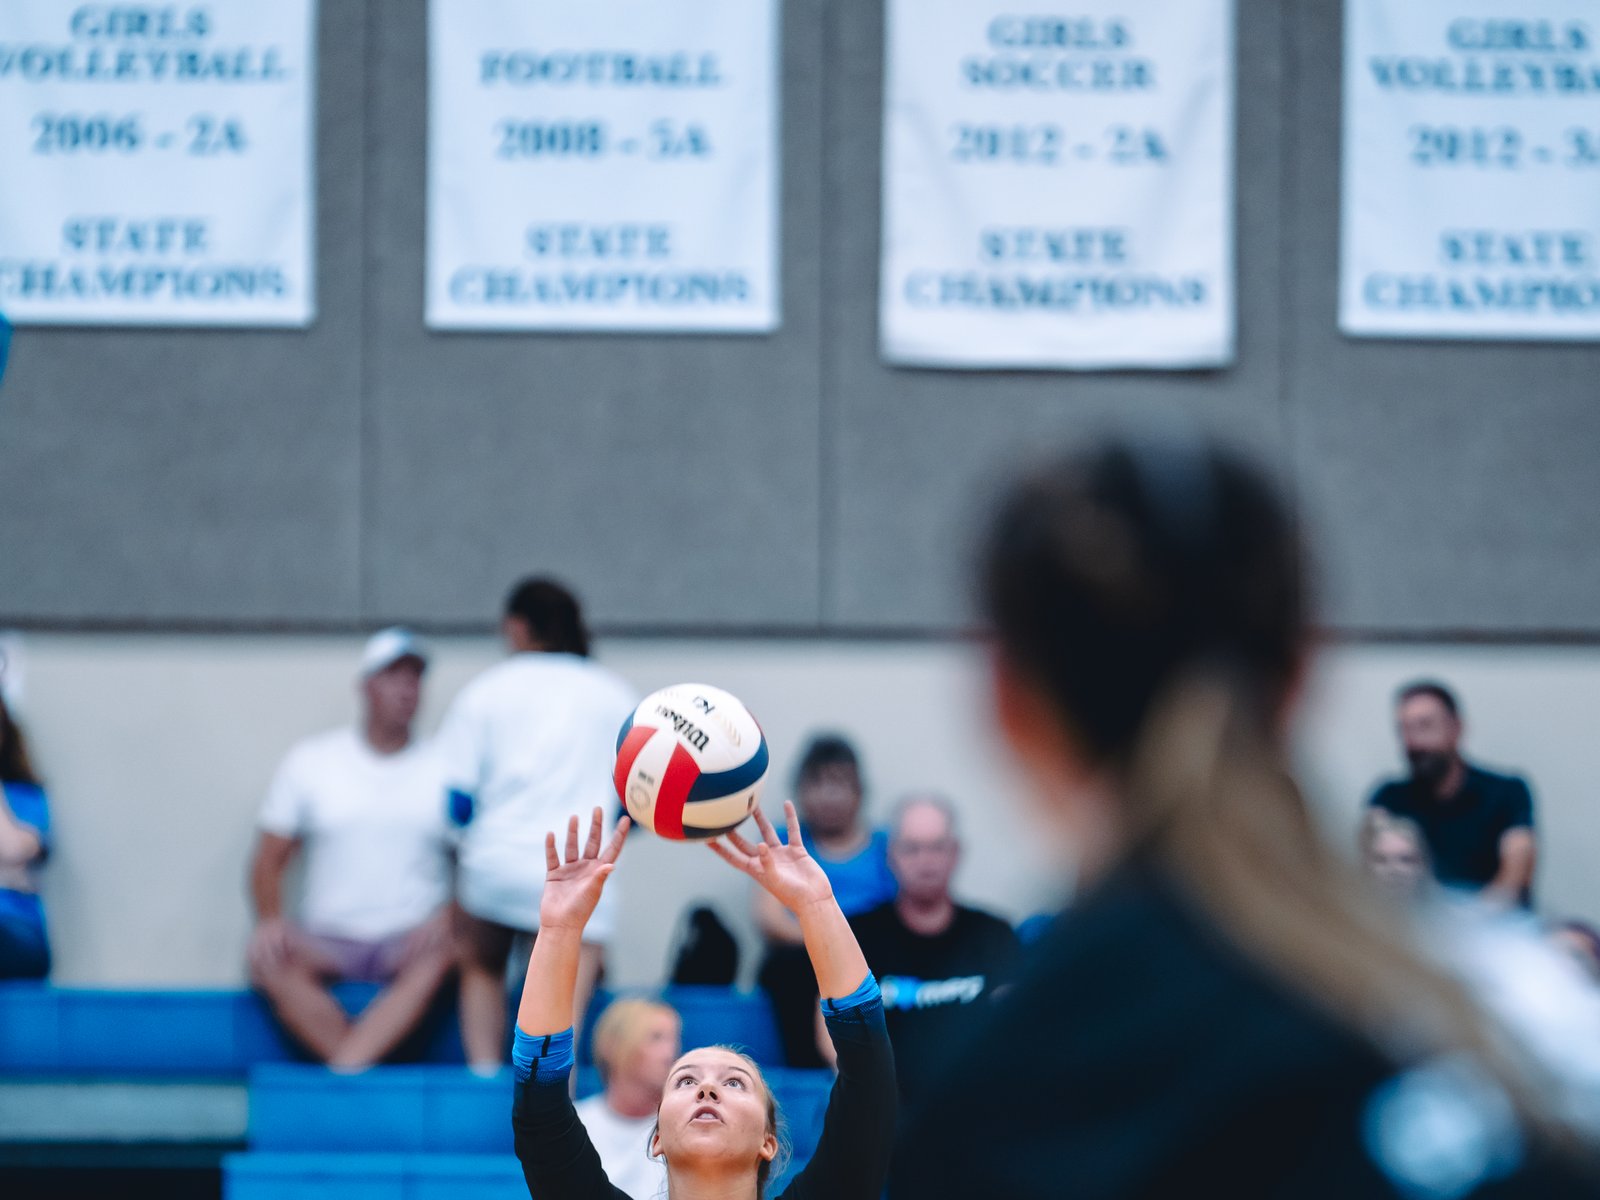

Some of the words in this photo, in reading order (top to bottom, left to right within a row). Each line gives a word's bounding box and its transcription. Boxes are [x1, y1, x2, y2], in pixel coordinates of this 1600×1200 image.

[69, 4, 212, 40] GIRLS
[987, 16, 1132, 49] GIRLS
[1447, 19, 1590, 51] GIRLS
[480, 50, 725, 87] FOOTBALL
[962, 56, 1156, 91] SOCCER
[33, 113, 143, 153] 2006
[188, 114, 249, 155] 2A
[952, 124, 1062, 166] 2012
[1106, 124, 1170, 165] 2A
[1409, 125, 1522, 168] 2012
[63, 216, 208, 253] STATE
[526, 223, 672, 258] STATE
[981, 226, 1130, 264] STATE
[1441, 231, 1590, 267] STATE
[448, 266, 751, 304] CHAMPIONS
[904, 271, 1208, 311] CHAMPIONS
